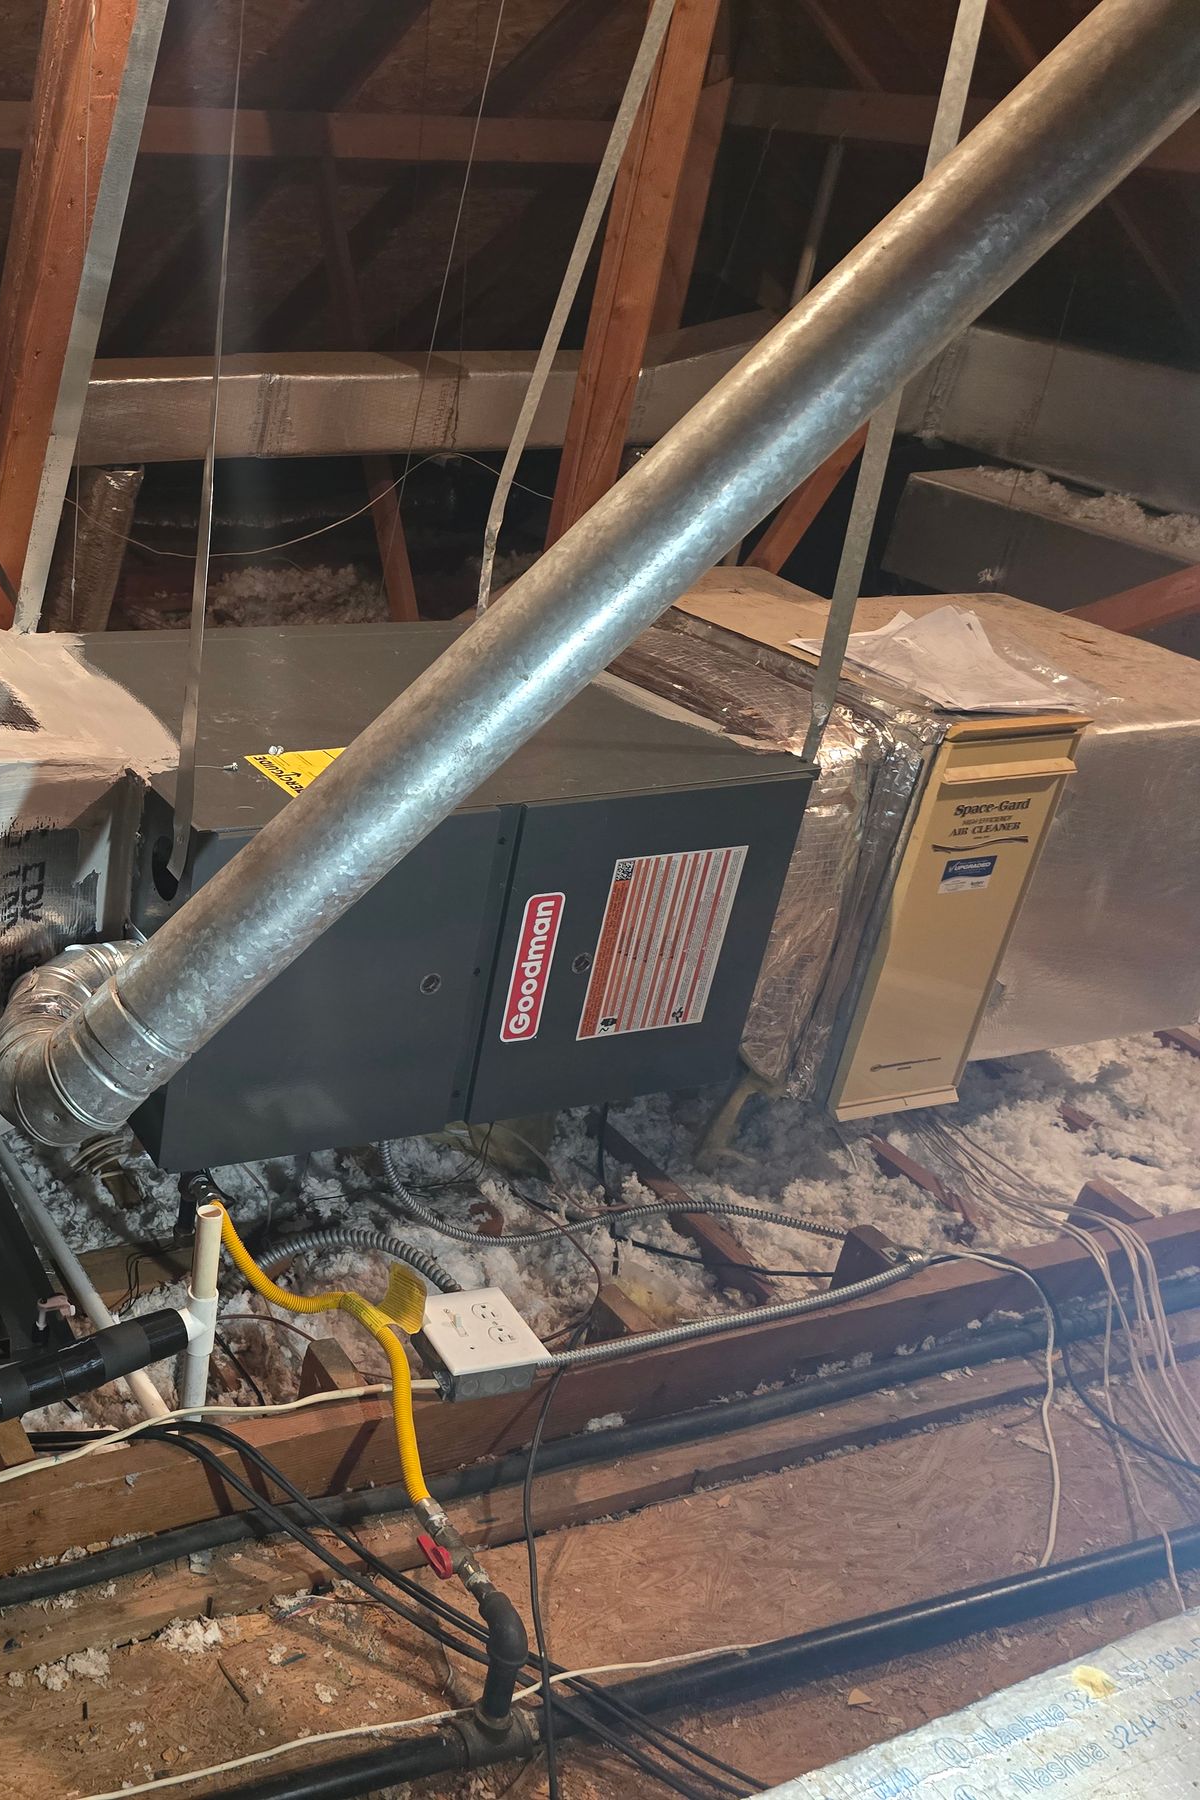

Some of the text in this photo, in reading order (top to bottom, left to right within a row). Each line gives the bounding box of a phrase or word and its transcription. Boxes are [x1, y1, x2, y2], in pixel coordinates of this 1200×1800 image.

[950, 821, 1021, 837] AIR CLEANER
[954, 798, 1032, 818] Space-Gard
[509, 900, 555, 1035] Goodman
[973, 1701, 1069, 1752] Nashua
[1013, 1741, 1108, 1795] Nashua
[1105, 1711, 1164, 1750] 324A
